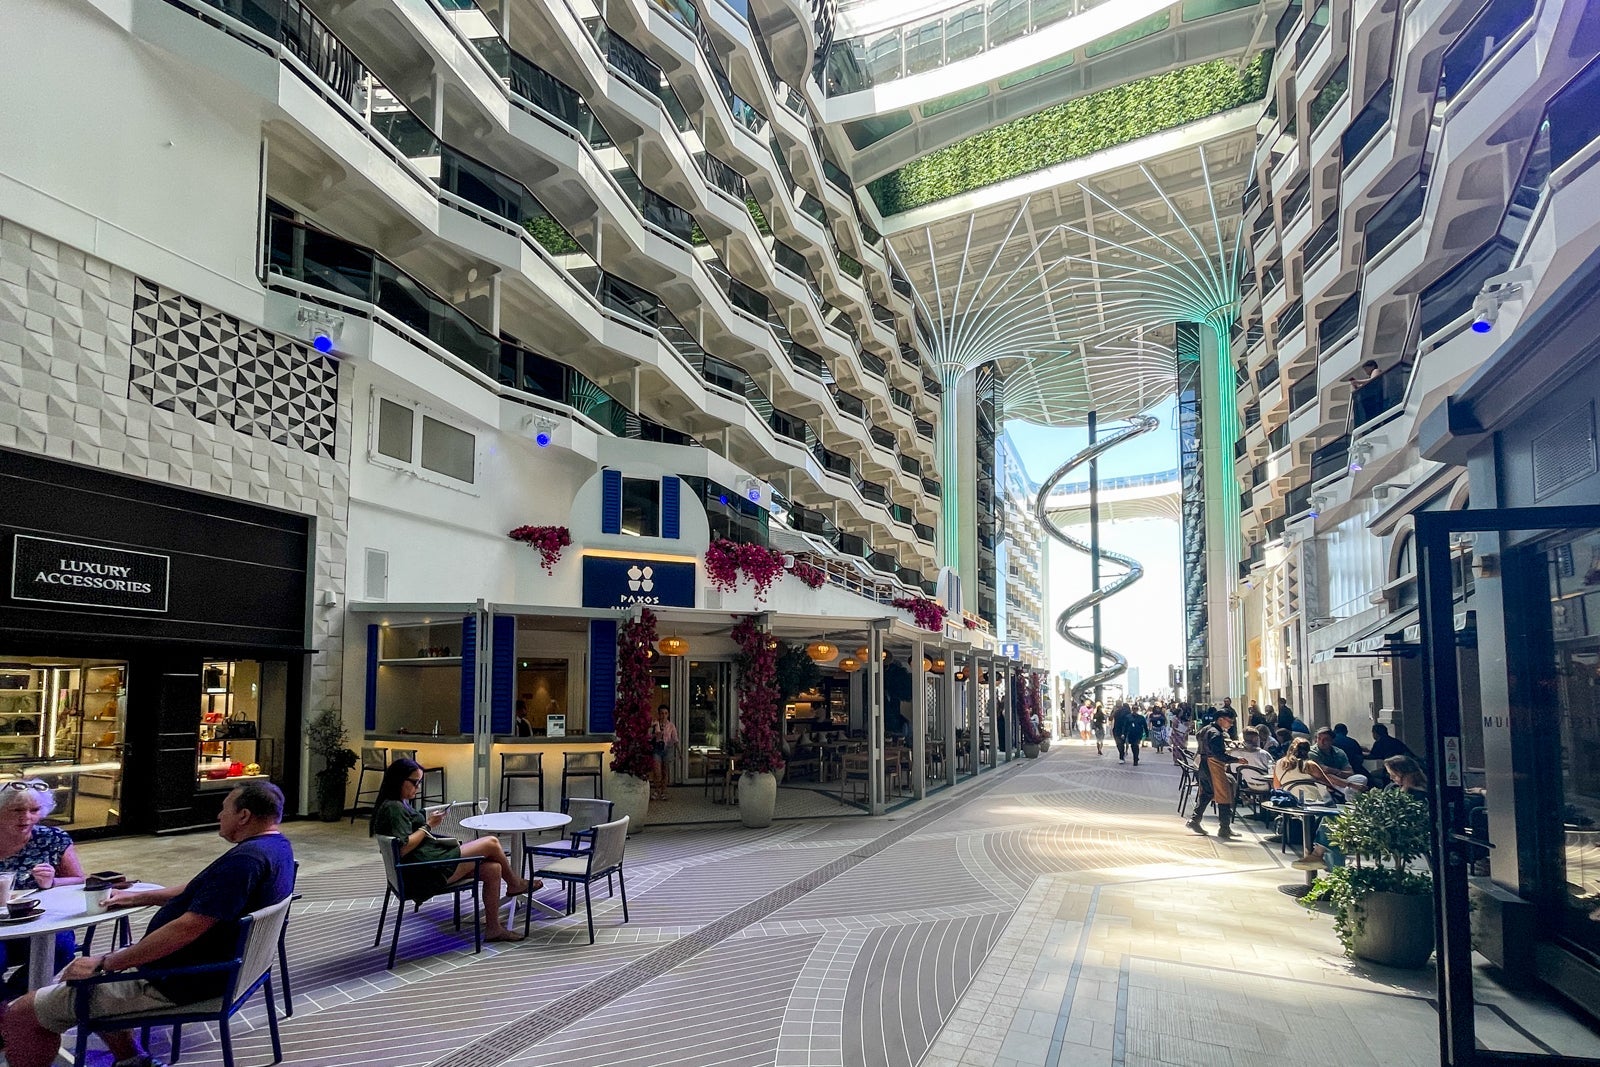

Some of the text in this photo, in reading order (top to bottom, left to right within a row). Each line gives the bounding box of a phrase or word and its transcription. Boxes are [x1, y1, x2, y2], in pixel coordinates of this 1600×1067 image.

[60, 559, 131, 578] LUXURY
[35, 571, 151, 593] ACCESSORIES
[620, 595, 659, 604] PAXOS
